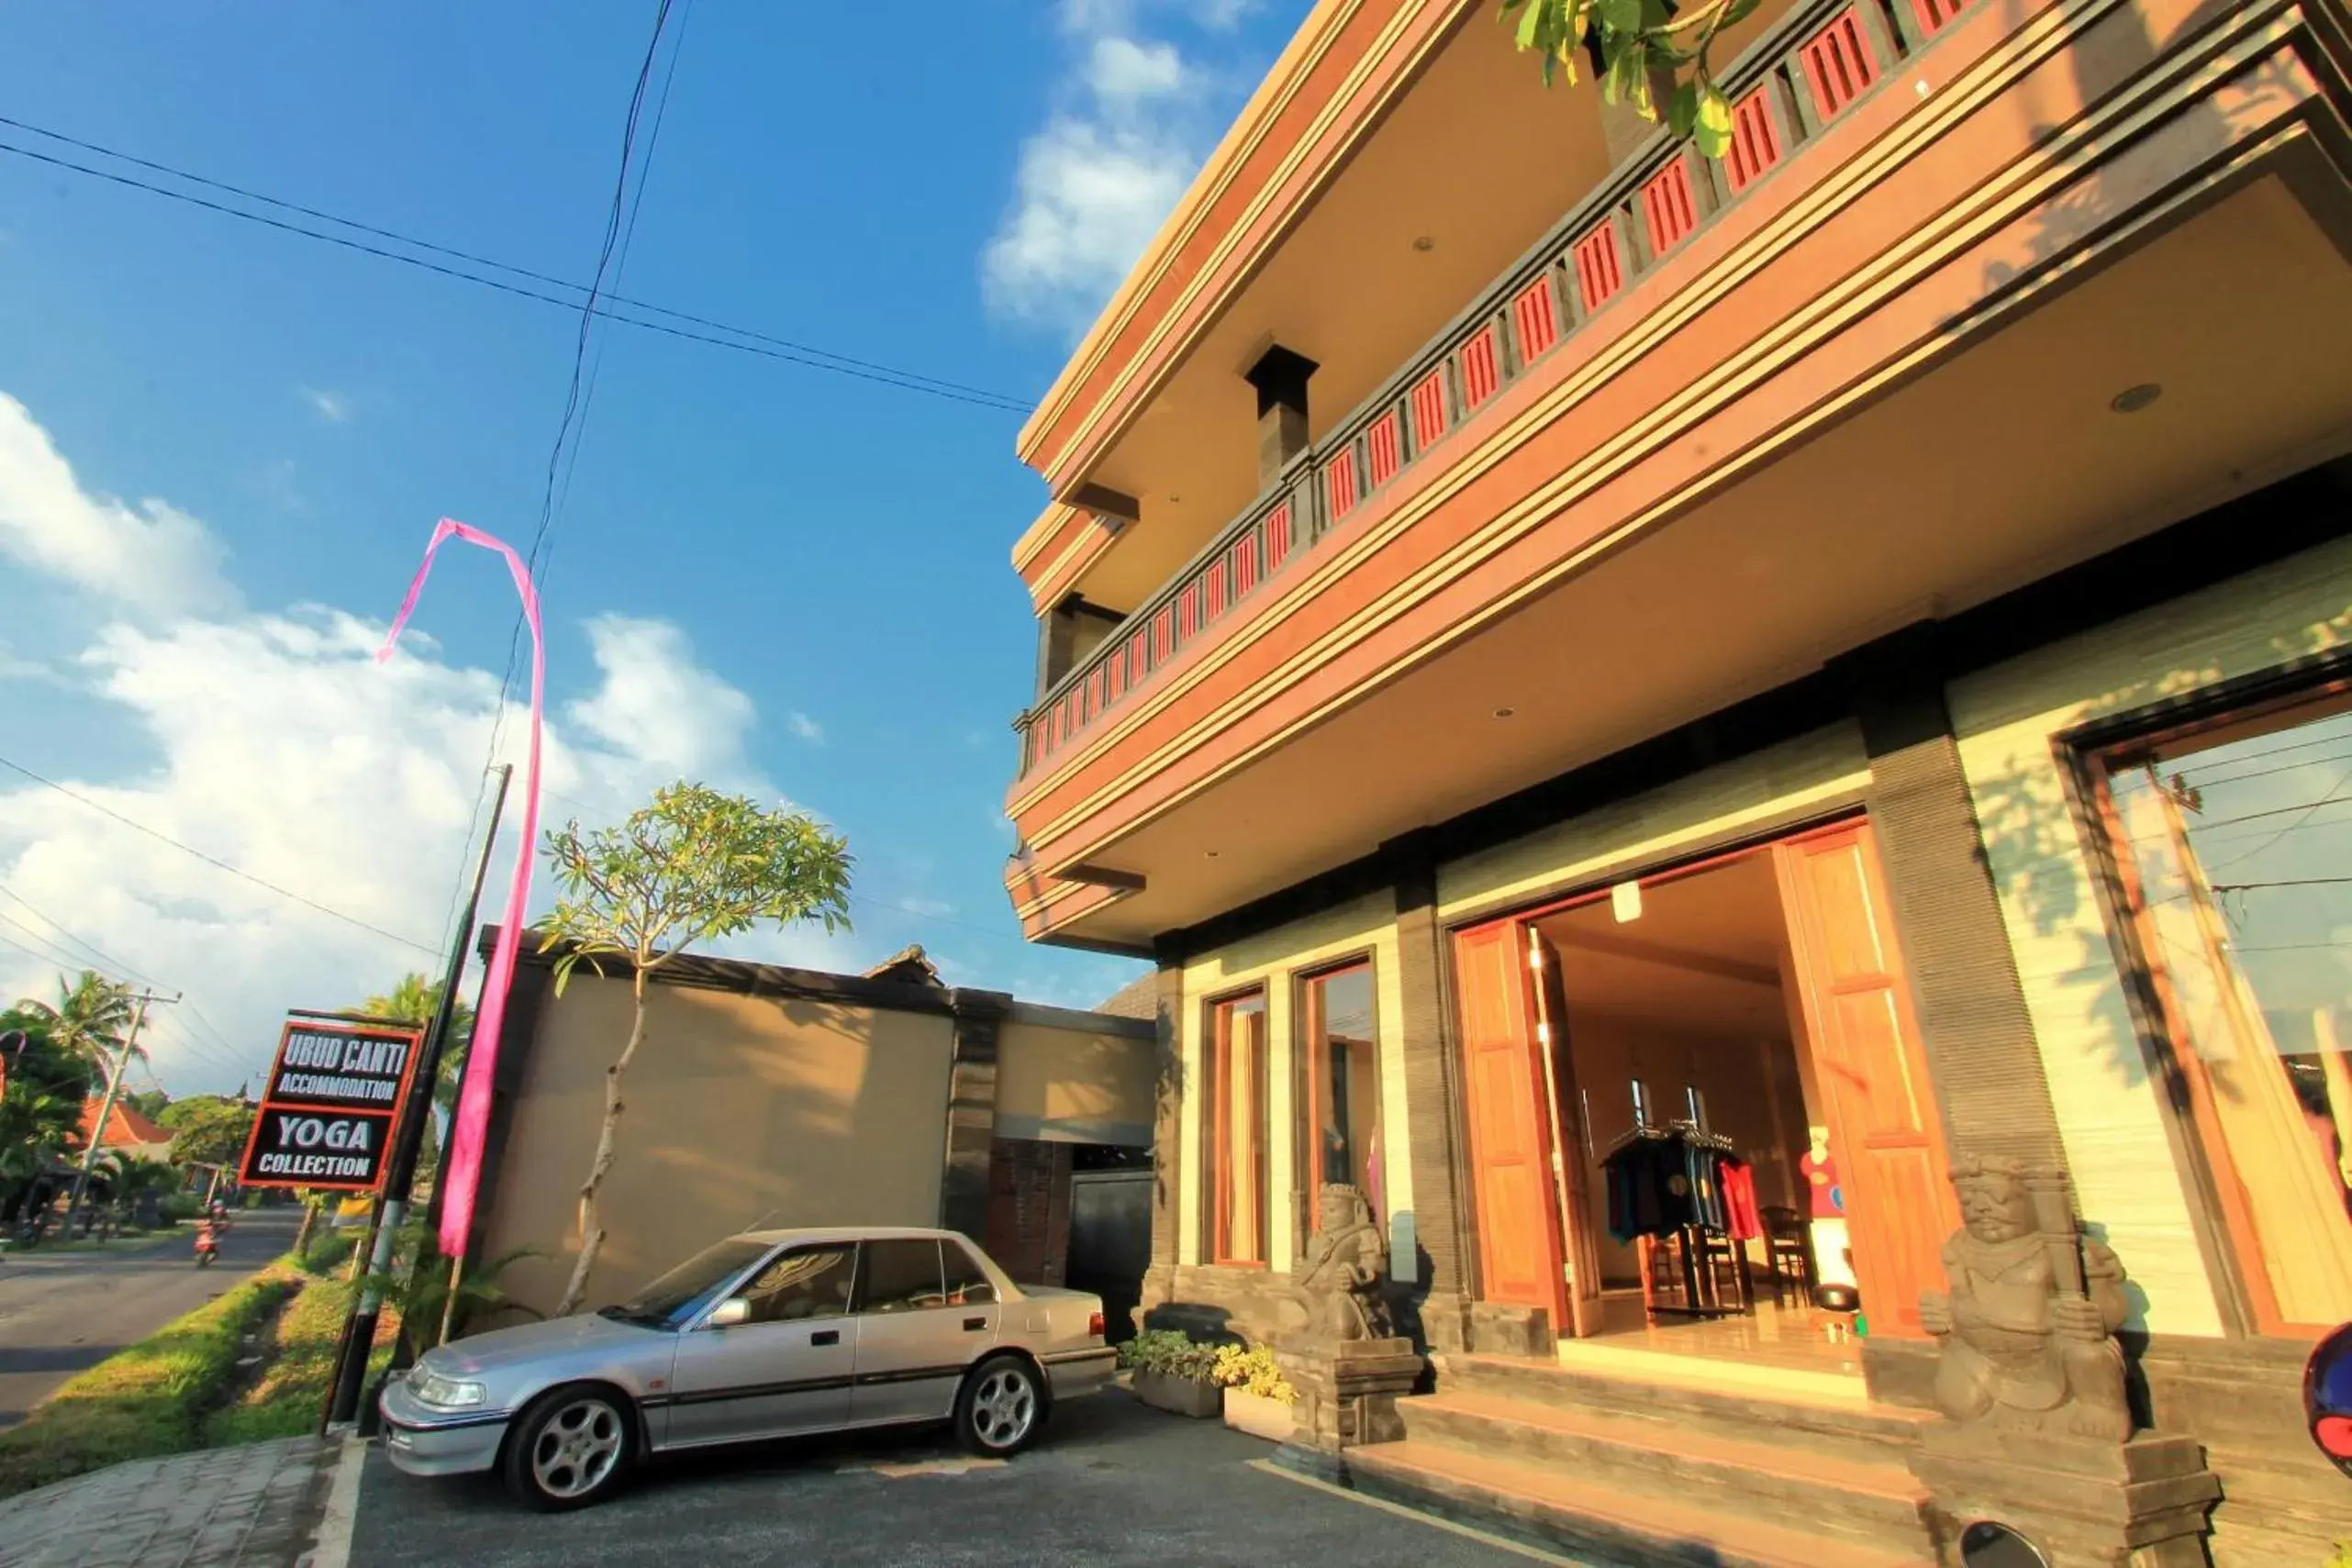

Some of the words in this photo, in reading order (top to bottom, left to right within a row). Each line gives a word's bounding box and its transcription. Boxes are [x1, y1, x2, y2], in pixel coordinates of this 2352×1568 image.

[284, 1034, 340, 1069] UBUD
[278, 1073, 396, 1100] ACCOMMODATION
[279, 1116, 369, 1151] YOGA
[259, 1153, 370, 1176] COLLECTION
